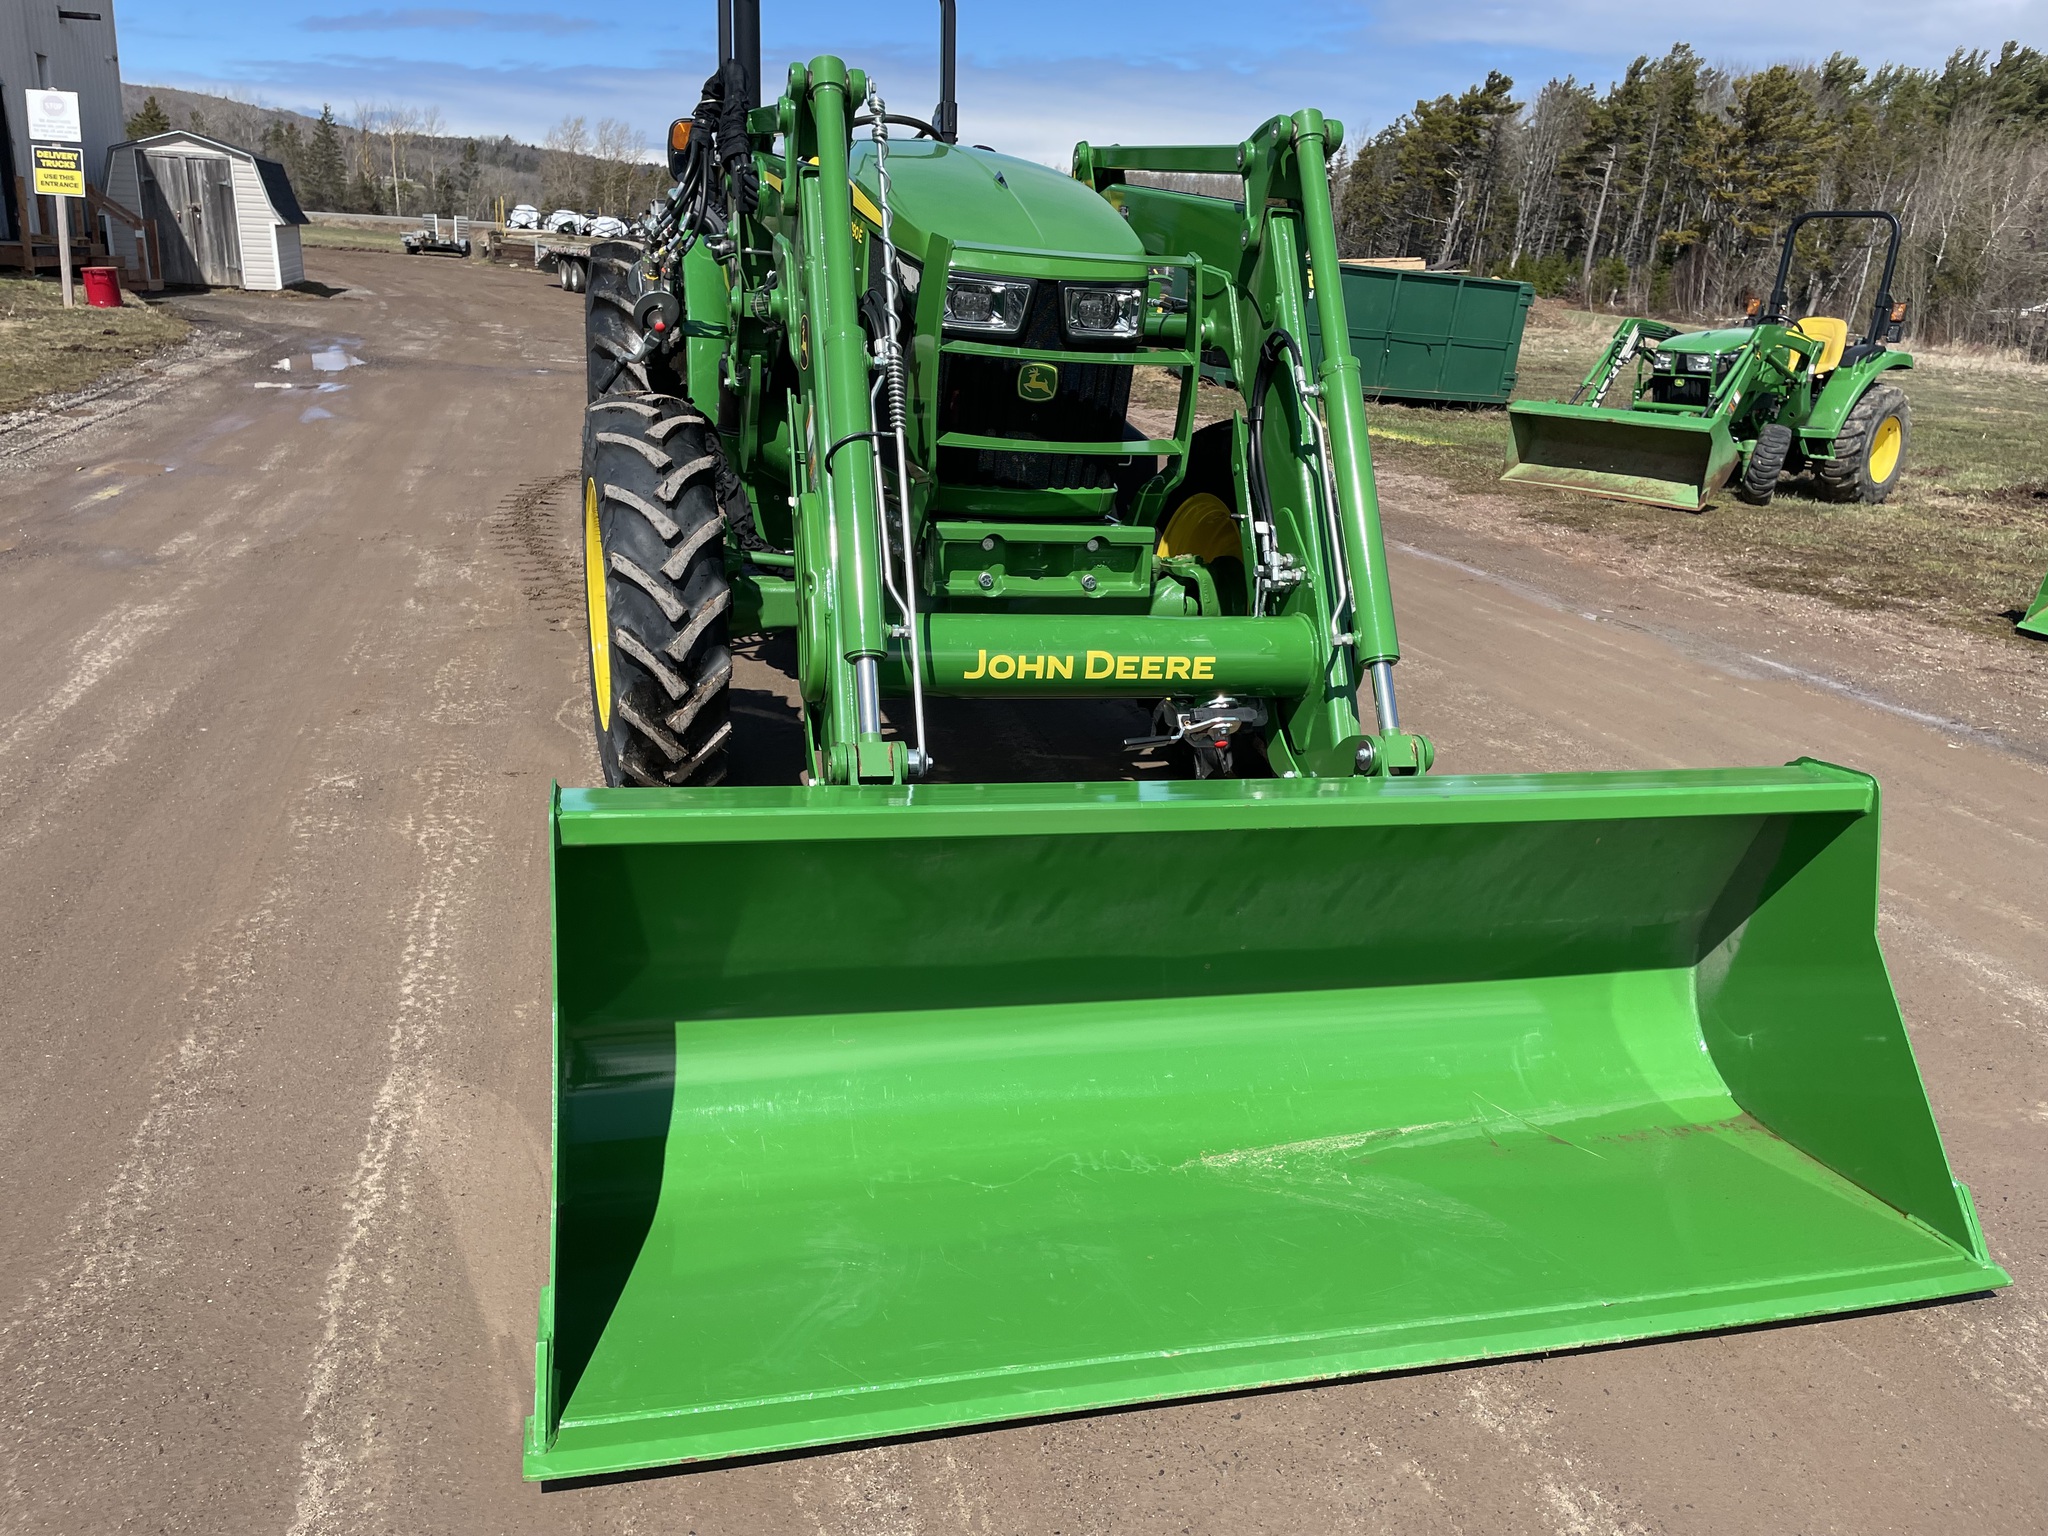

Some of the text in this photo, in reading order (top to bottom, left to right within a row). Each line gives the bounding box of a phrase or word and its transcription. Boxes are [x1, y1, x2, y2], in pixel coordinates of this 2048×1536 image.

[44, 102, 63, 110] STOP
[36, 150, 78, 160] DELIVERY
[40, 159, 76, 169] TRUCKS
[40, 180, 79, 189] ENTRANCE
[963, 649, 1216, 680] JOHN DEERE
